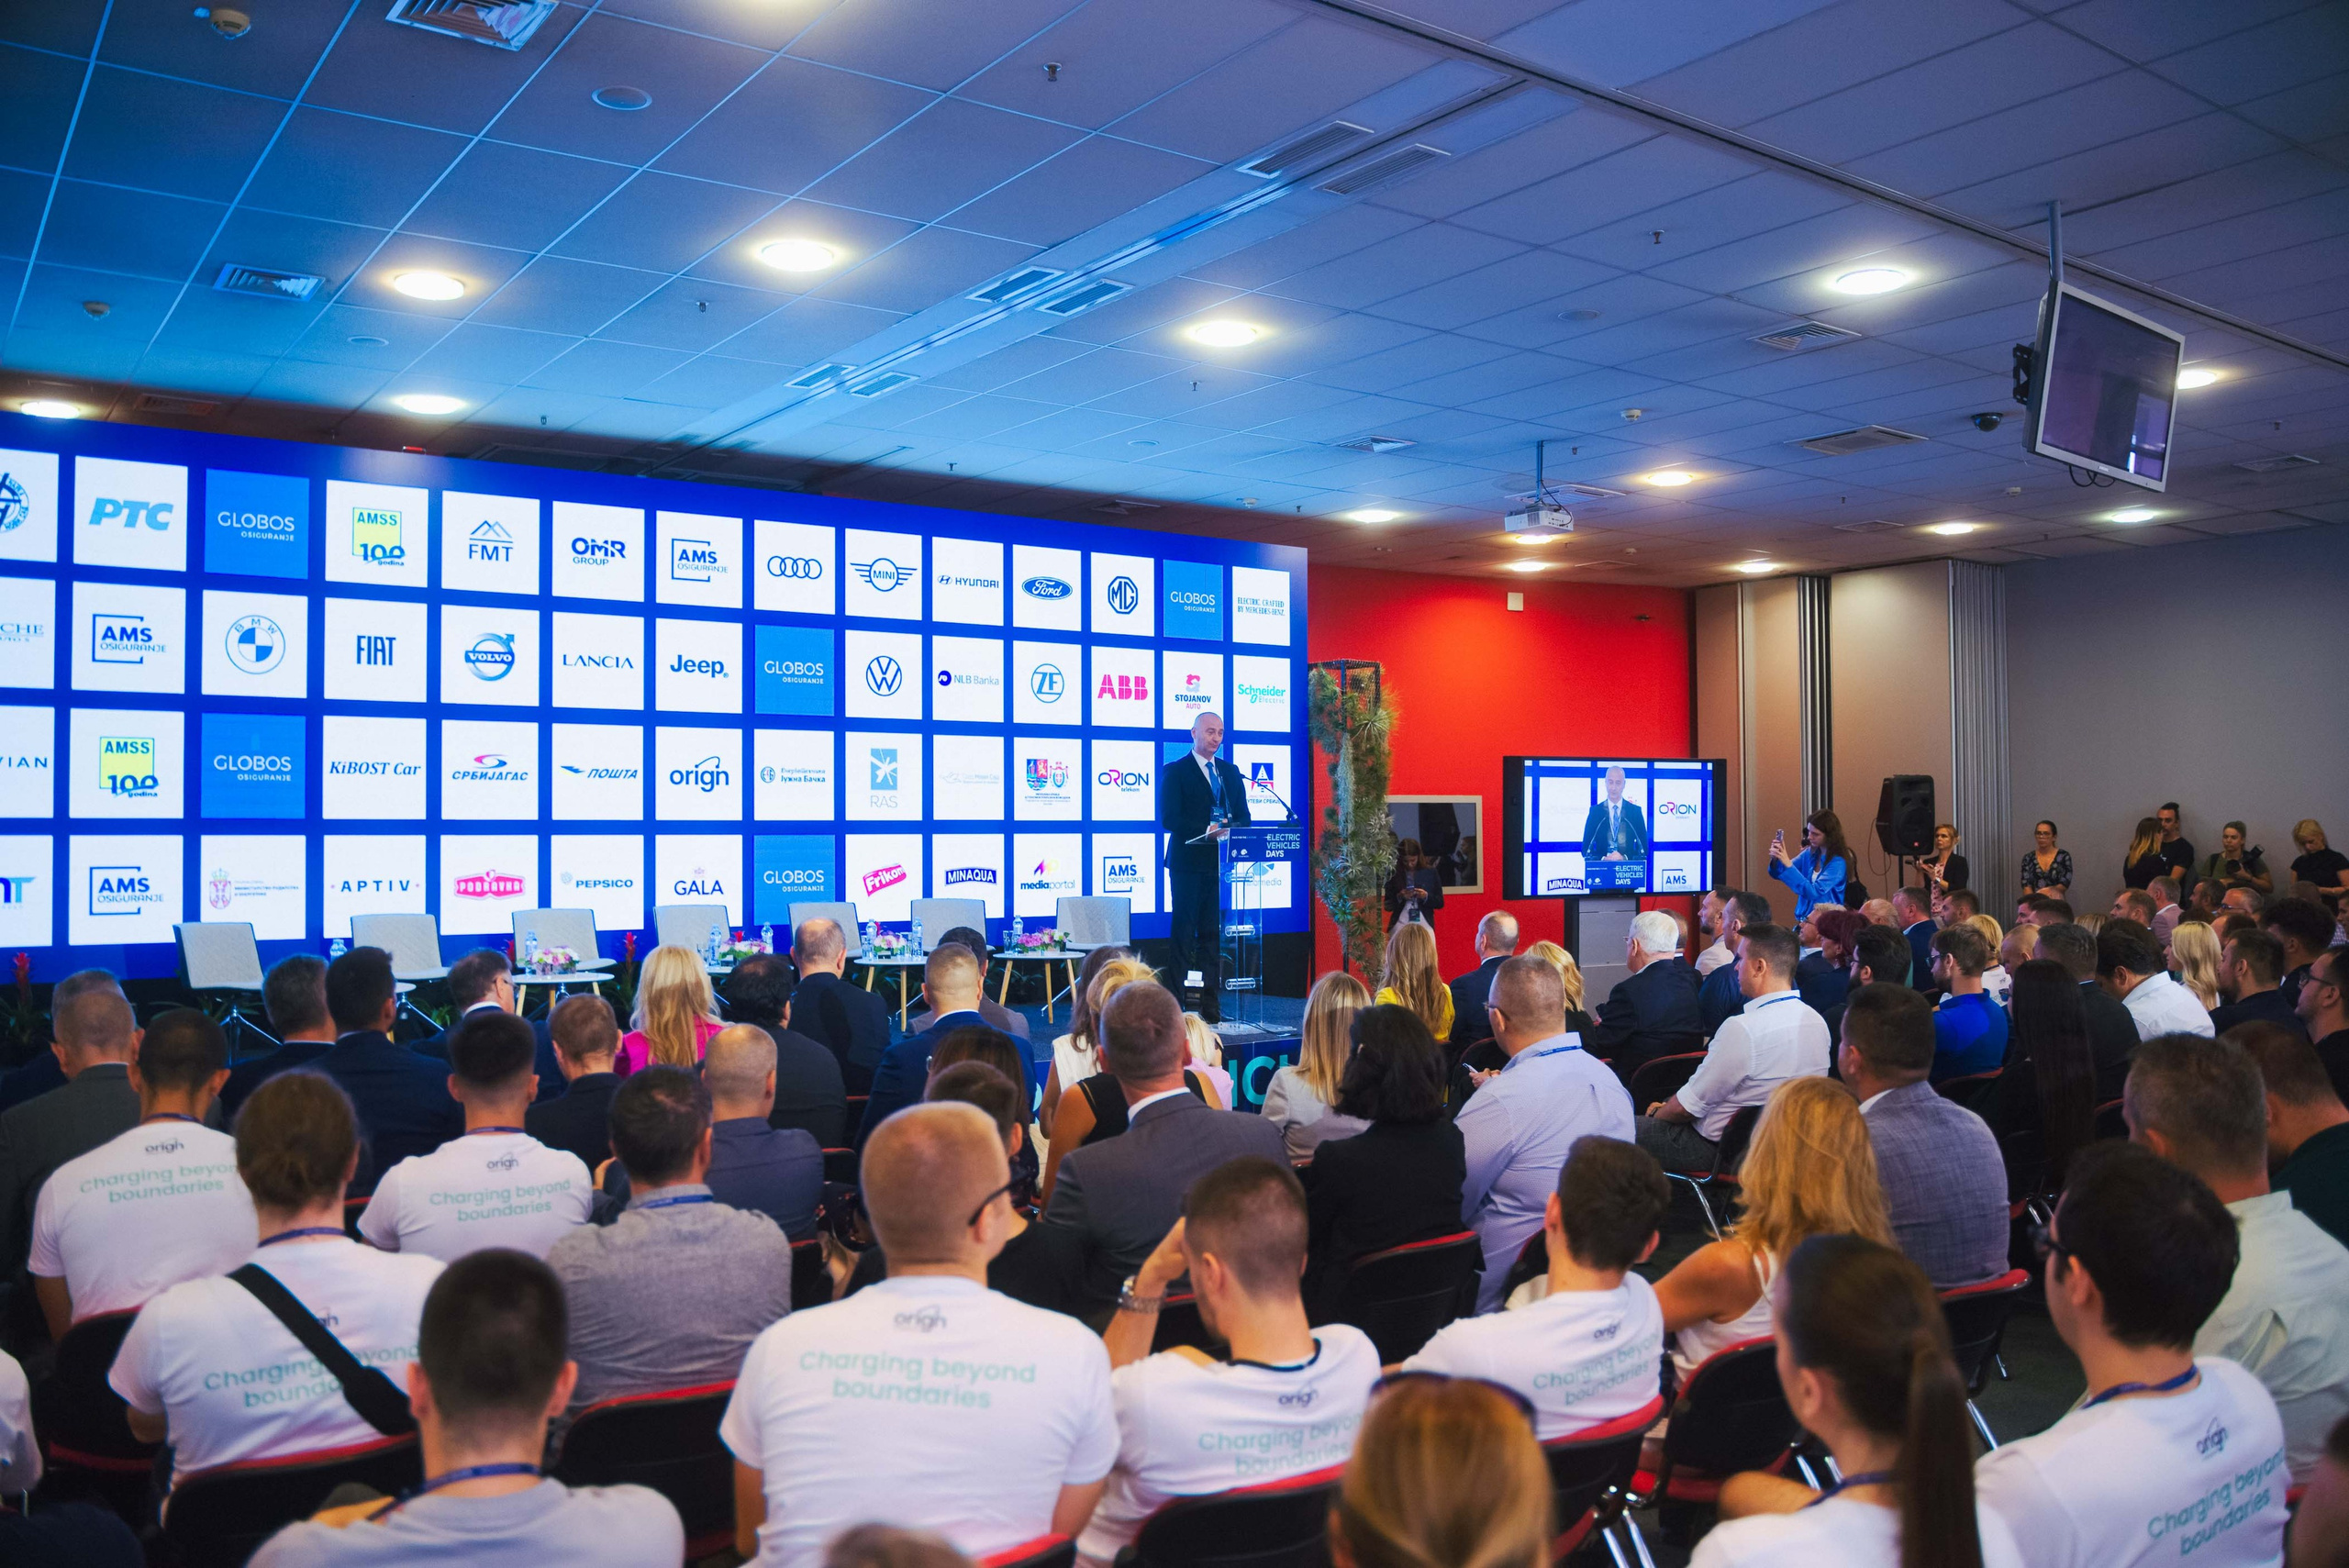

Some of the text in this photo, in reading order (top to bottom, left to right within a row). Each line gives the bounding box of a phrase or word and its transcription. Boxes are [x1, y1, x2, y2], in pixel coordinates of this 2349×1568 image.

[217, 511, 295, 532] GLOBOS
[356, 511, 398, 526] AMSS
[240, 530, 295, 542] OSIGURANJE
[359, 543, 406, 562] 100
[469, 543, 514, 562] FMT
[571, 537, 627, 559] OMR
[573, 556, 609, 566] GROUP
[678, 549, 718, 564] AMS
[677, 562, 729, 573] OSIGURANJE
[873, 570, 896, 580] MINI
[955, 576, 999, 589] HYUNDAI
[1031, 579, 1063, 596] Ford
[1111, 581, 1135, 610] MG
[1170, 591, 1216, 606] GLOBOS
[1262, 599, 1285, 607] CRAFTED
[1184, 605, 1216, 613] OSIGURANJE
[234, 617, 278, 635] BMW
[101, 626, 152, 642] AMS
[100, 642, 166, 653] OSIGURANJE
[356, 635, 396, 666] FIAT
[467, 651, 513, 662] VOLVO
[562, 654, 634, 669] LANCIA
[764, 660, 824, 676] GLOBOS
[782, 676, 824, 684] OSIGURANJE
[953, 674, 1000, 685] NLB Banka
[1034, 671, 1062, 695] ZF
[1097, 673, 1149, 701] ABB
[1238, 684, 1286, 697] Schneider
[1174, 694, 1211, 704] STOJANOV
[105, 741, 150, 754] AMSS
[213, 755, 292, 772] GLOBOS
[329, 761, 421, 775] KiBOST Car
[237, 773, 292, 782] OSIGURANJE
[587, 768, 638, 779] ПОШТА
[670, 763, 729, 793] orign
[1097, 769, 1149, 787] ORION
[107, 775, 159, 795] 100
[128, 790, 158, 798] godina
[870, 795, 898, 808] RAS
[1658, 801, 1697, 816] ORION
[1266, 833, 1300, 841] ELECTRIC
[1266, 841, 1300, 850] VEHICLES
[1265, 850, 1285, 858] DAYS
[763, 870, 825, 884] GLOBOS
[947, 869, 995, 884] MINAQUA
[1108, 864, 1138, 877] AMS
[98, 878, 150, 894] AMS
[340, 880, 411, 893] APTIV
[575, 879, 633, 888] PEPSICO
[864, 865, 906, 893] Frikom
[1020, 879, 1075, 891] mediaportal
[1548, 879, 1583, 890] MINAQUA
[1665, 875, 1687, 884] AMS
[674, 879, 724, 895] GALA
[97, 894, 164, 904] OSIGURANJE
[80, 1163, 239, 1194] Charging beyon
[108, 1179, 224, 1203] boundaries
[429, 1180, 571, 1206] Charging beyond
[457, 1200, 552, 1222] boundaries
[205, 1357, 322, 1391] Charging
[799, 1351, 1036, 1384] Charging beyond
[1532, 1355, 1613, 1390] Charging
[1564, 1360, 1649, 1407] boundaries
[832, 1378, 992, 1409] boundaries
[1197, 1428, 1304, 1453] Charging
[1235, 1442, 1349, 1474] boundaries
[2147, 1482, 2232, 1540] Charging
[2180, 1487, 2271, 1556] boundaries
